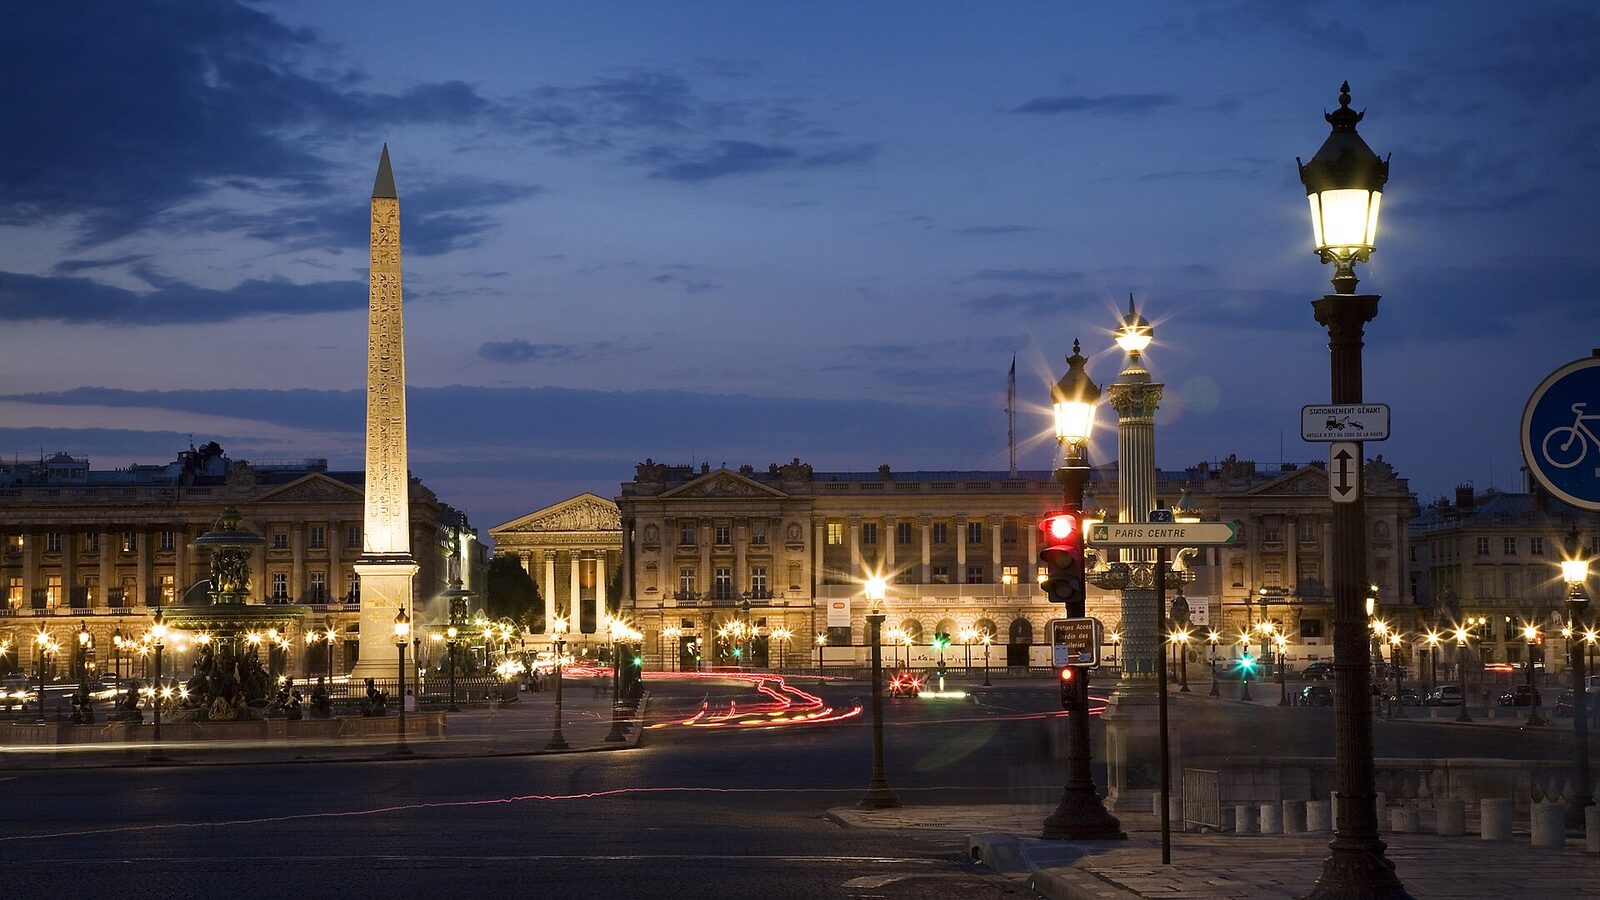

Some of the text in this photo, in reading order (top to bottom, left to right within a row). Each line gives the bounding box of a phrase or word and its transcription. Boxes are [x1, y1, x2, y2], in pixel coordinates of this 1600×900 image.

[1309, 407, 1354, 415] STATIONNEMENT
[1115, 529, 1186, 538] PARIS CENTRE
